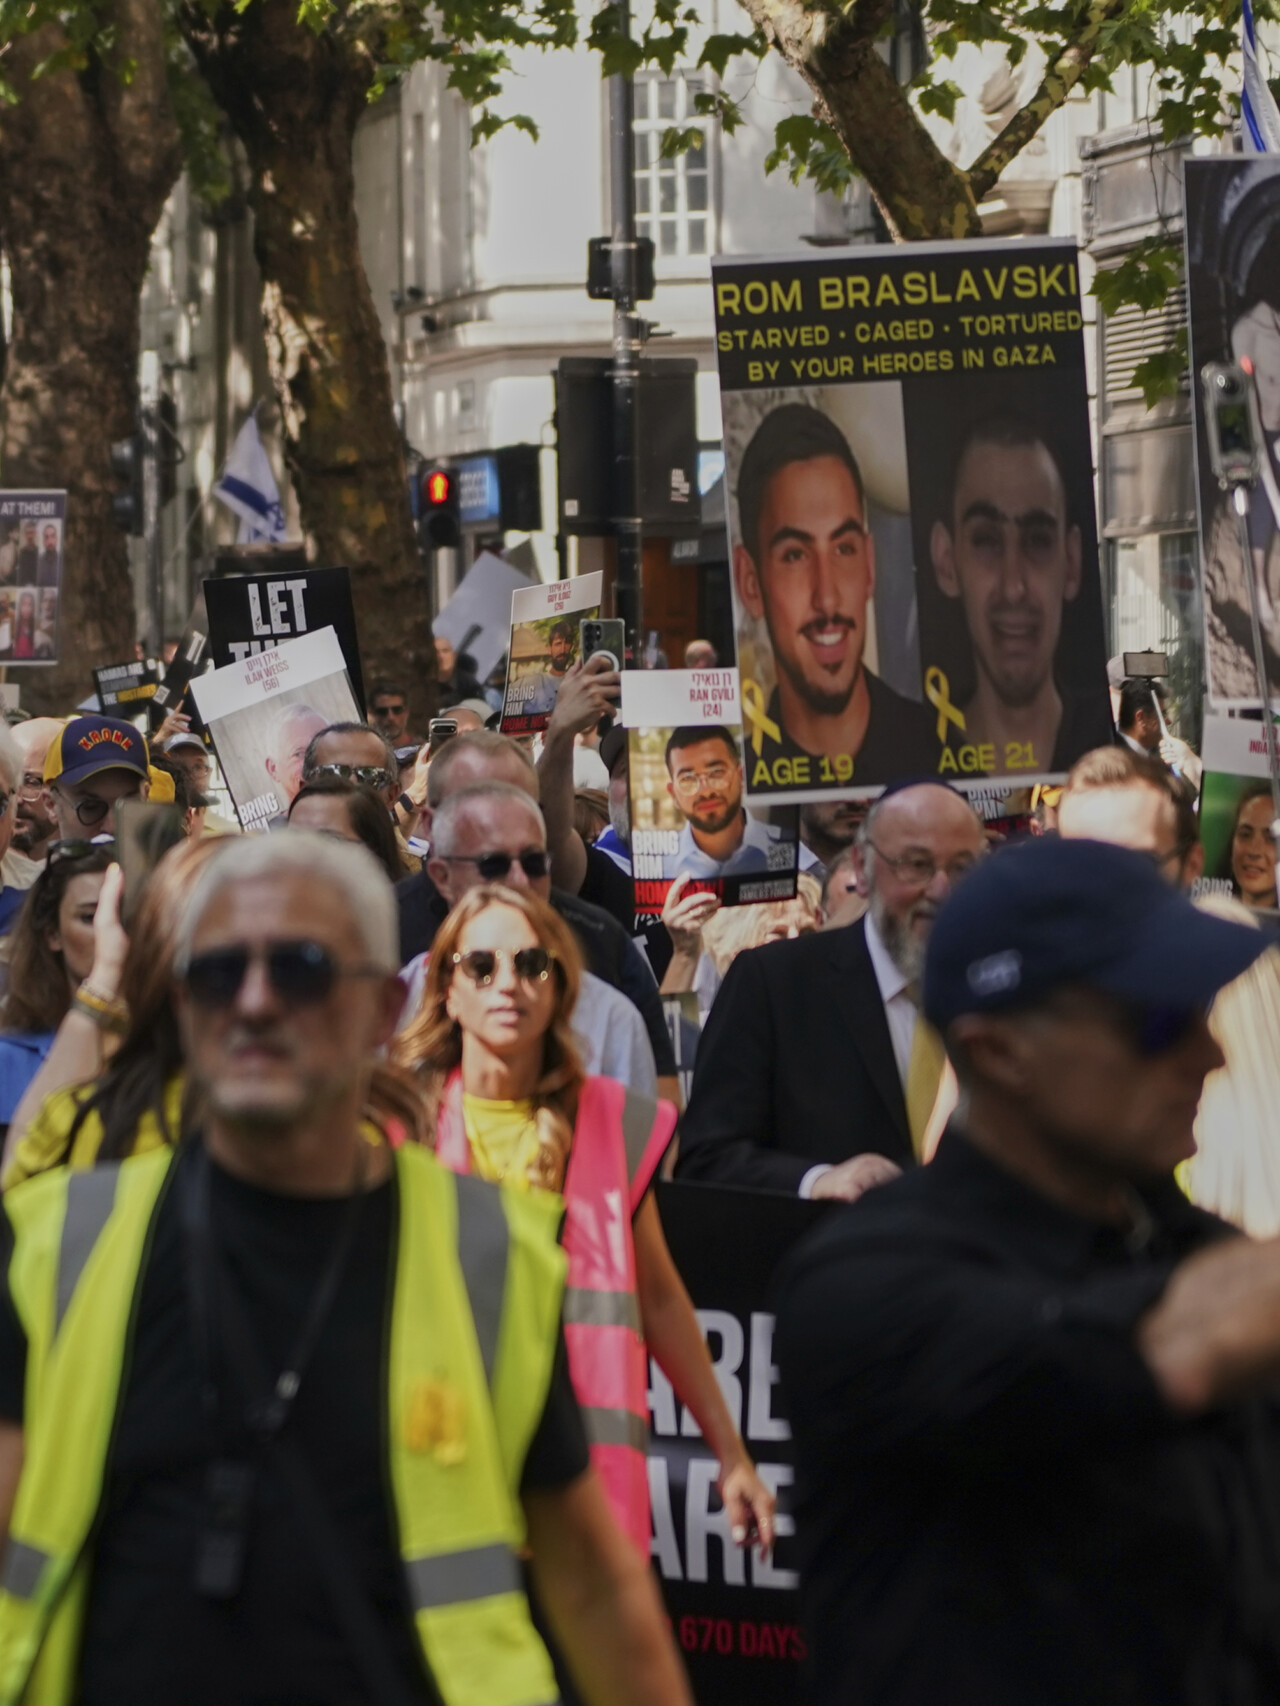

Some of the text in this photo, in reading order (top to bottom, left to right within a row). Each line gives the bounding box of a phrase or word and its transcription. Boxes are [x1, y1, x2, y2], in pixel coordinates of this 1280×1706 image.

[717, 262, 1077, 317] ROM BRASLAVSKI
[717, 309, 1083, 352] STARVED CAGED TORTURED
[747, 343, 1057, 382] BY YOUR HEROES IN GAZA
[0, 501, 16, 516] AT
[17, 501, 56, 516] THEM!
[248, 579, 308, 636] LET
[245, 660, 289, 686] ILAN WEISS
[507, 685, 535, 703] BRING
[690, 688, 734, 702] RAN GVILI
[504, 701, 524, 717] HIM
[703, 703, 722, 718] (24)
[751, 753, 855, 788] AGE 19
[937, 741, 1039, 775] AGE 21
[238, 792, 279, 826] BRING
[631, 829, 679, 856] BRING
[633, 855, 664, 880] HIM
[634, 879, 671, 905] HOM
[679, 1615, 807, 1661] 670 DAYS
